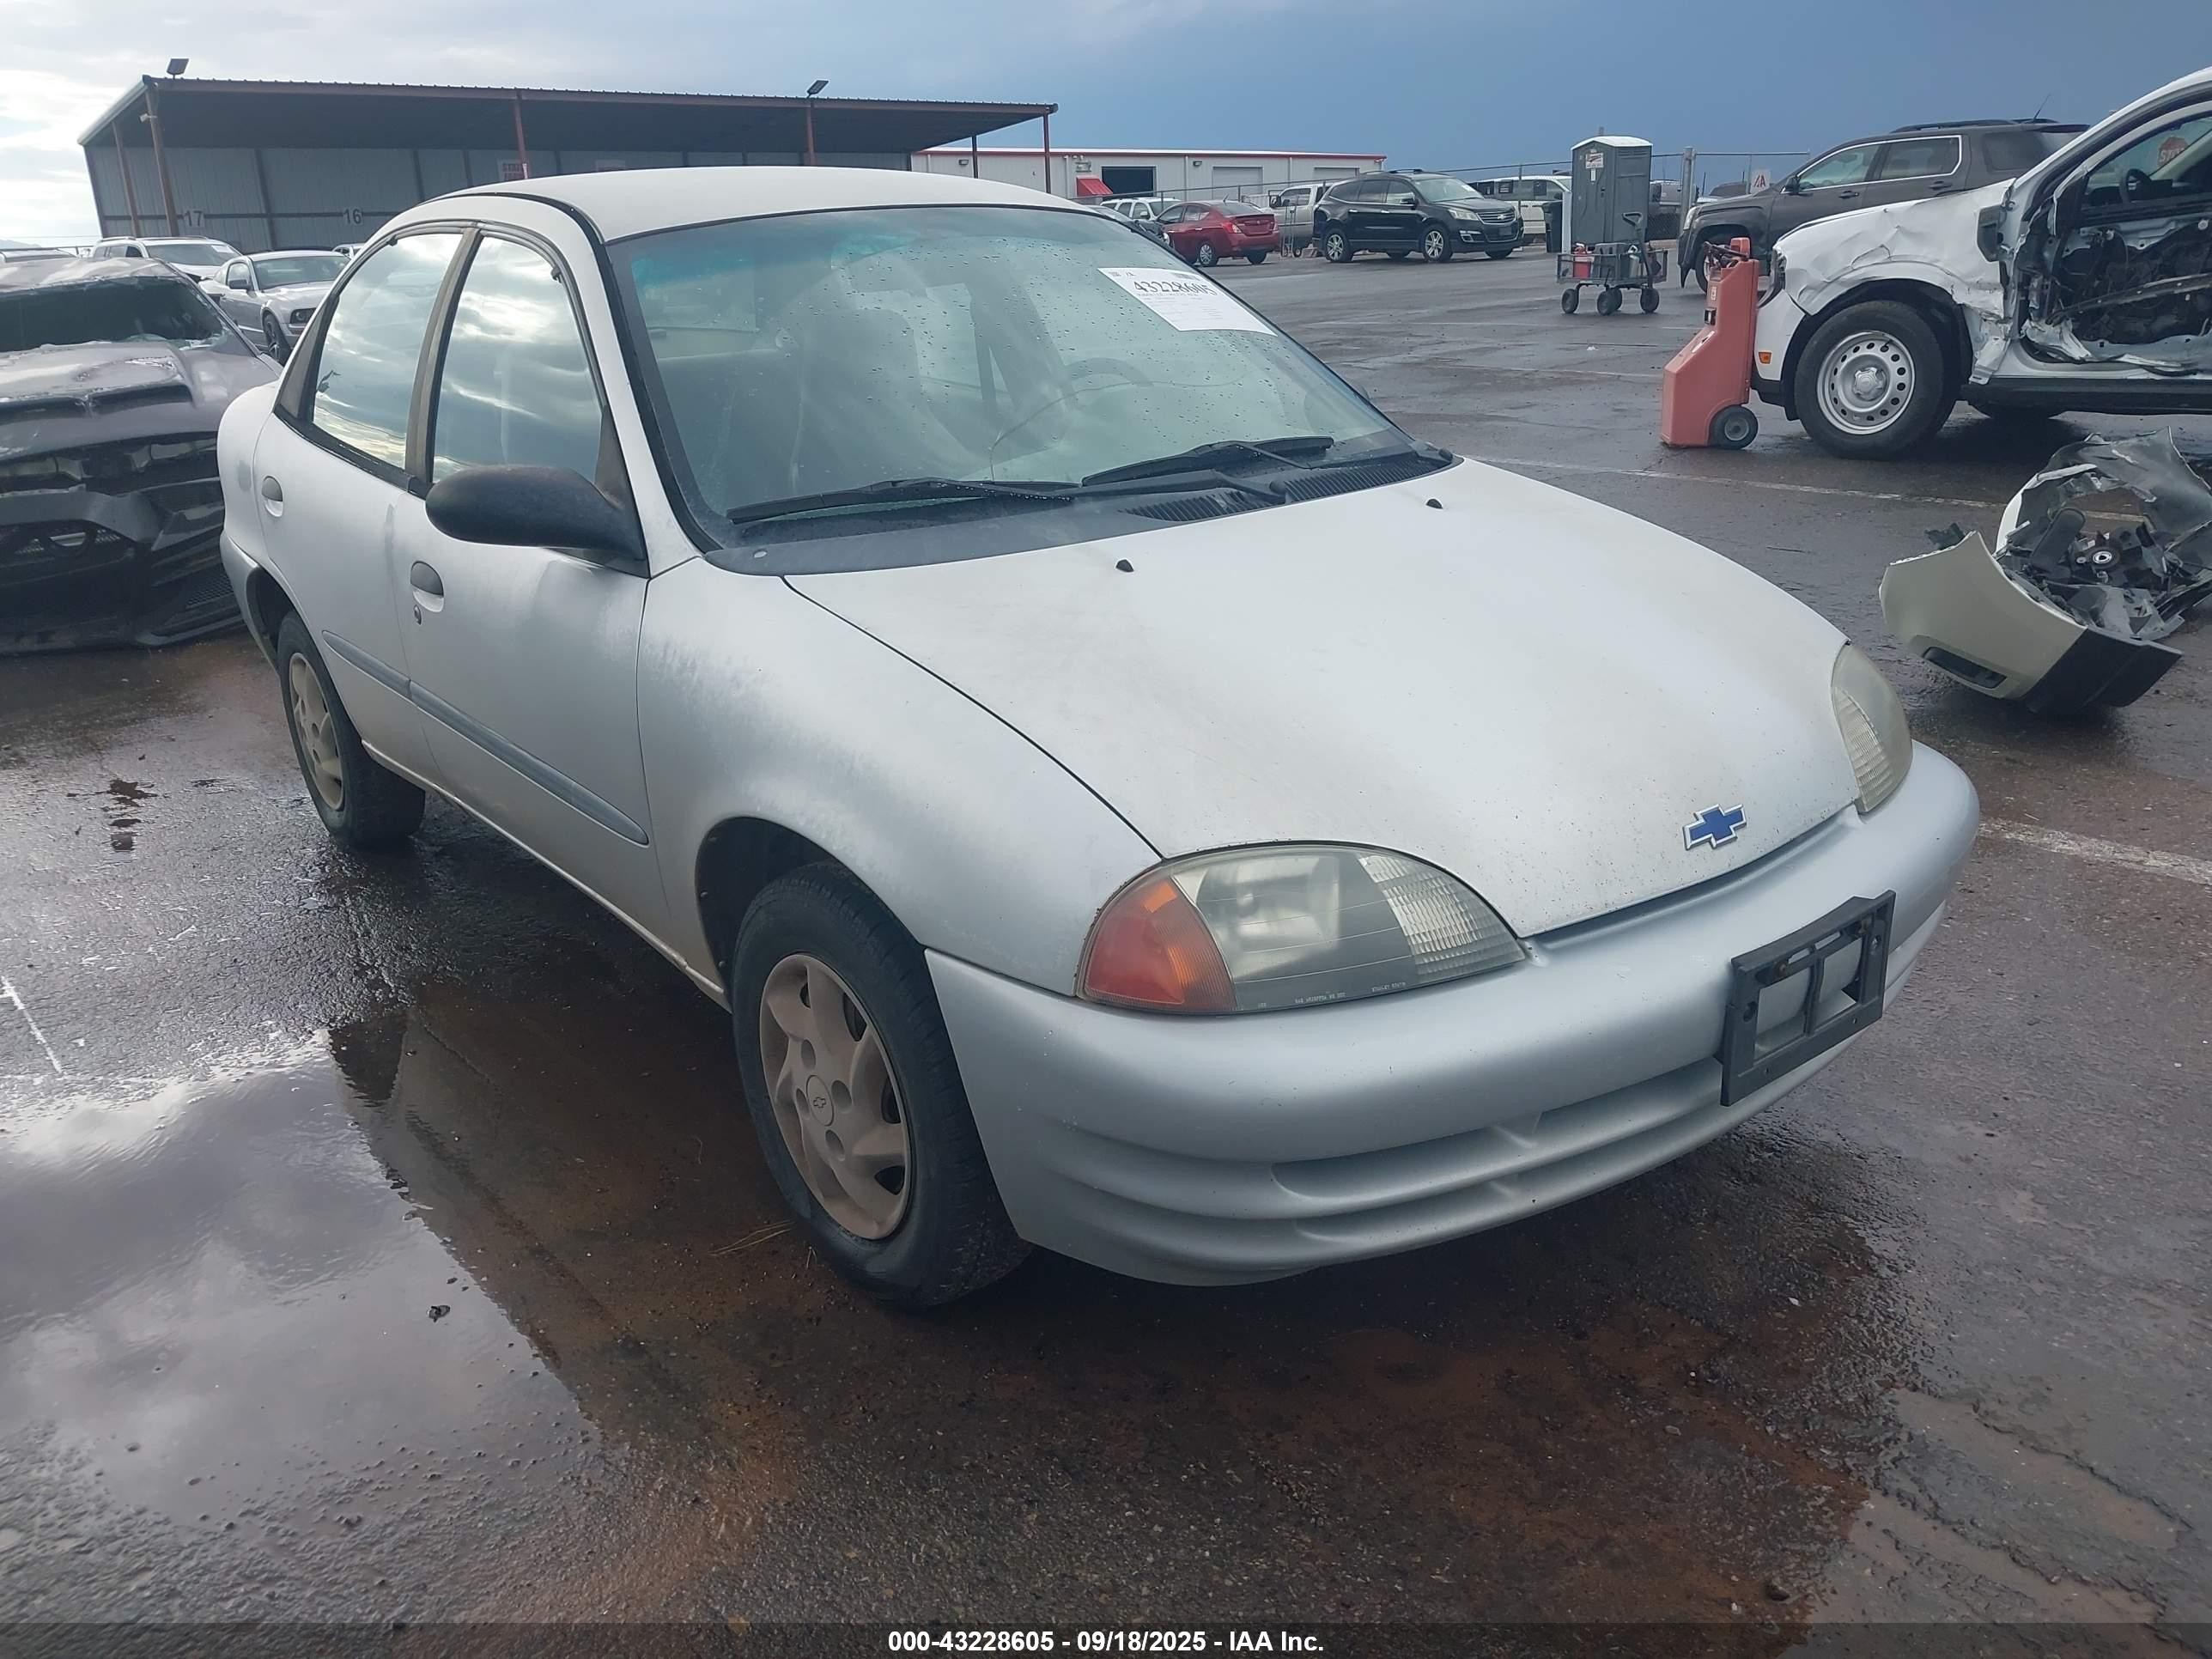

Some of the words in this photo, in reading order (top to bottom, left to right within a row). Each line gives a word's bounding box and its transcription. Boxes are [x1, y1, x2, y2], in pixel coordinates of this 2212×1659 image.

[185, 210, 203, 227] 17
[343, 209, 362, 224] 16
[1133, 281, 1218, 296] 43228605
